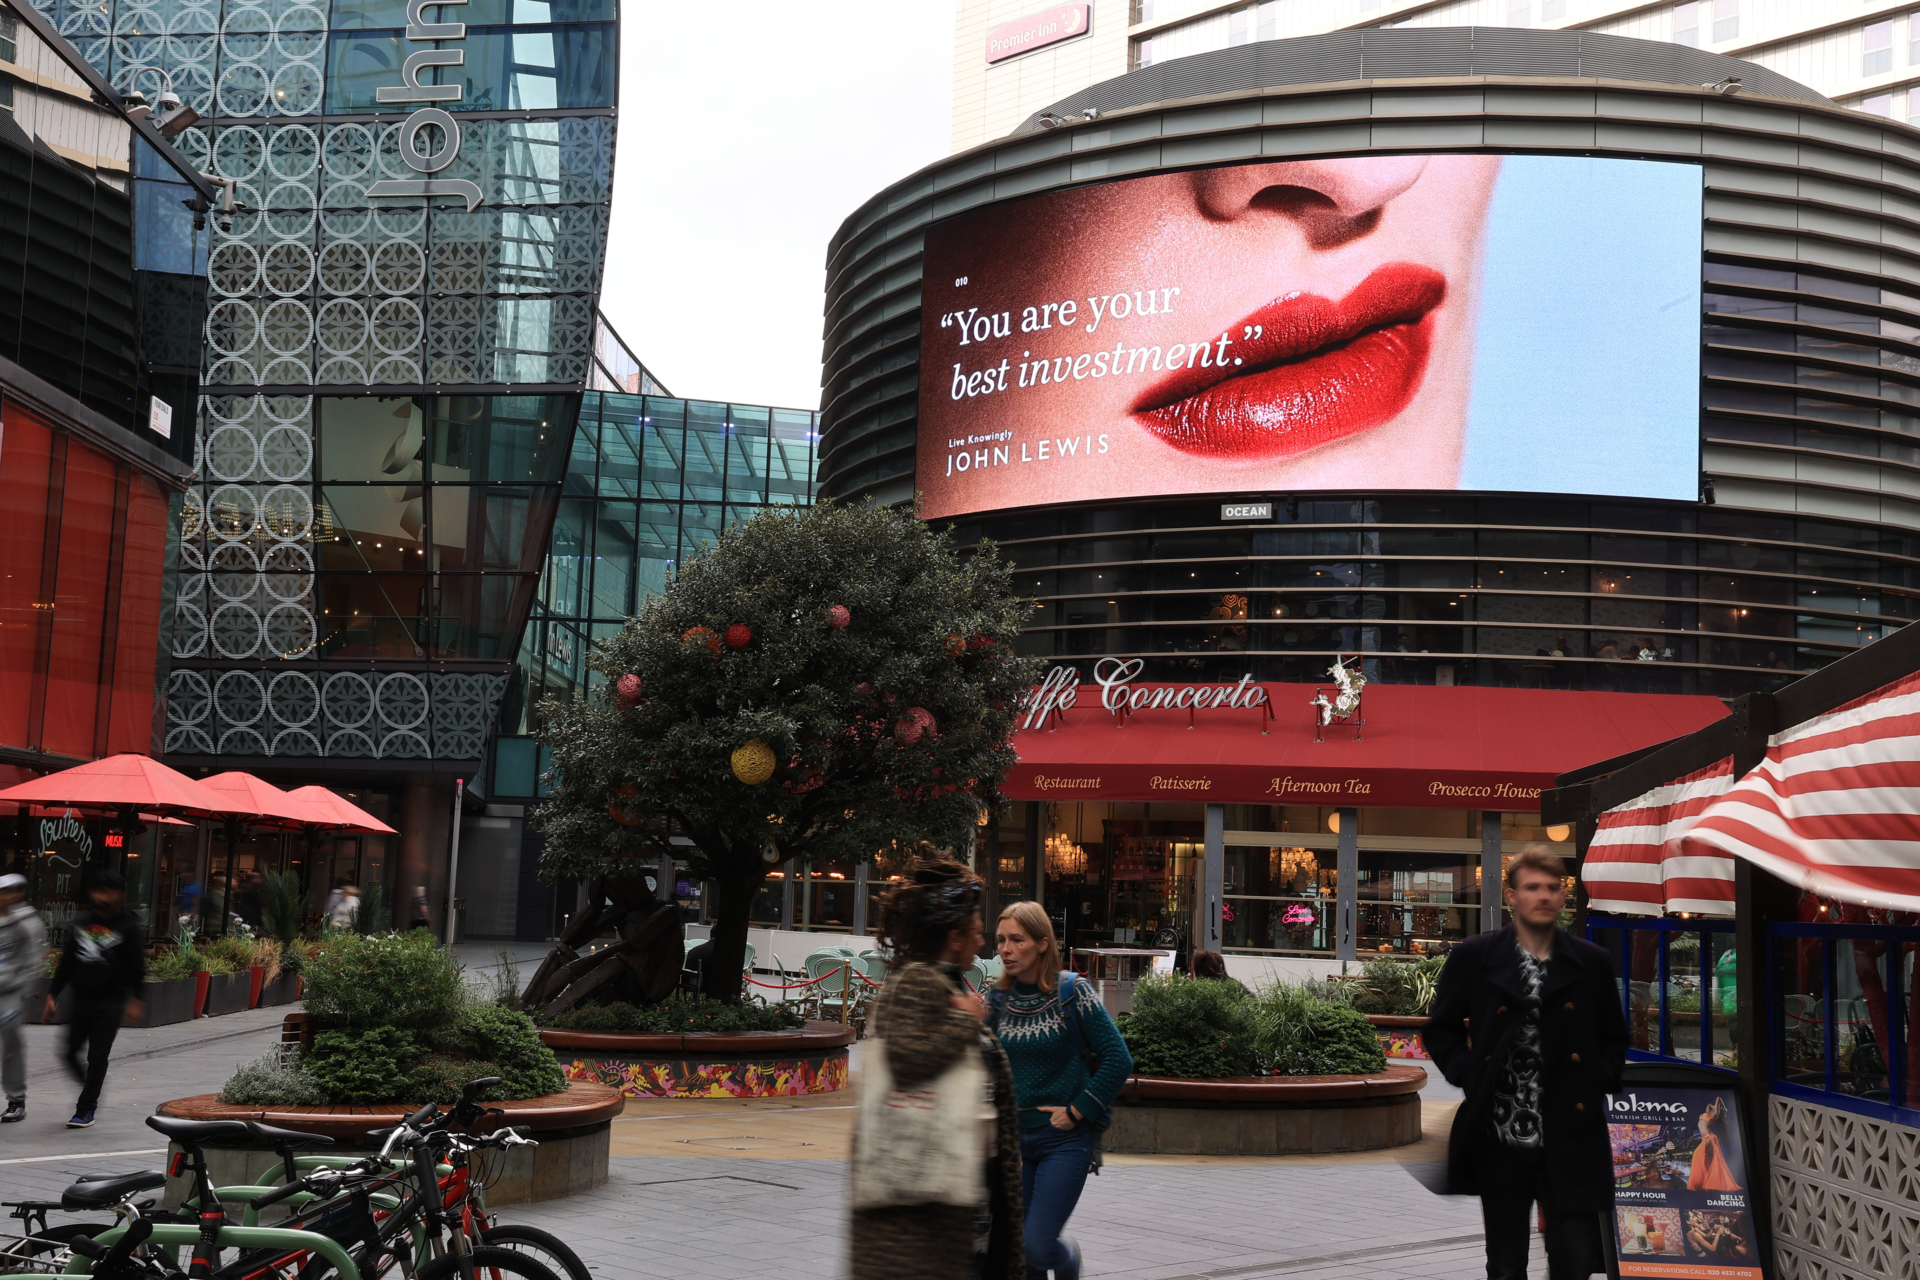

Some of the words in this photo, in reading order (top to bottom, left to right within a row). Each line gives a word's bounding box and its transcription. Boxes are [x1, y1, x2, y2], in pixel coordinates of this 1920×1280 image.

[990, 29, 1037, 54] Premier
[1039, 22, 1057, 38] Inn
[955, 276, 968, 287] 010
[1021, 299, 1077, 333] are
[1085, 286, 1181, 333] your
[951, 358, 1010, 401] best
[1018, 325, 1263, 389] investment.”
[948, 438, 965, 448] Live
[968, 429, 1013, 444] Knowingly
[946, 445, 1009, 477] JOHN
[1021, 433, 1109, 463] LEWIS
[1225, 506, 1267, 517] OCEAN
[1093, 657, 1268, 716] Concerto
[1034, 774, 1101, 791] Restaurant
[1150, 775, 1211, 791] Patisserie
[1266, 776, 1341, 797] Afternoon
[1344, 779, 1371, 794] Tea
[1428, 781, 1491, 798] Prosecco
[1493, 783, 1541, 799] House
[38, 808, 92, 862] Southern
[56, 873, 71, 894] PIT
[1605, 1093, 1688, 1114] lokma
[1615, 1191, 1641, 1199] HAPPY
[1642, 1192, 1667, 1200] HOUR
[1707, 1199, 1745, 1207] DANCING
[1642, 1266, 1690, 1274] RESERVATIONS
